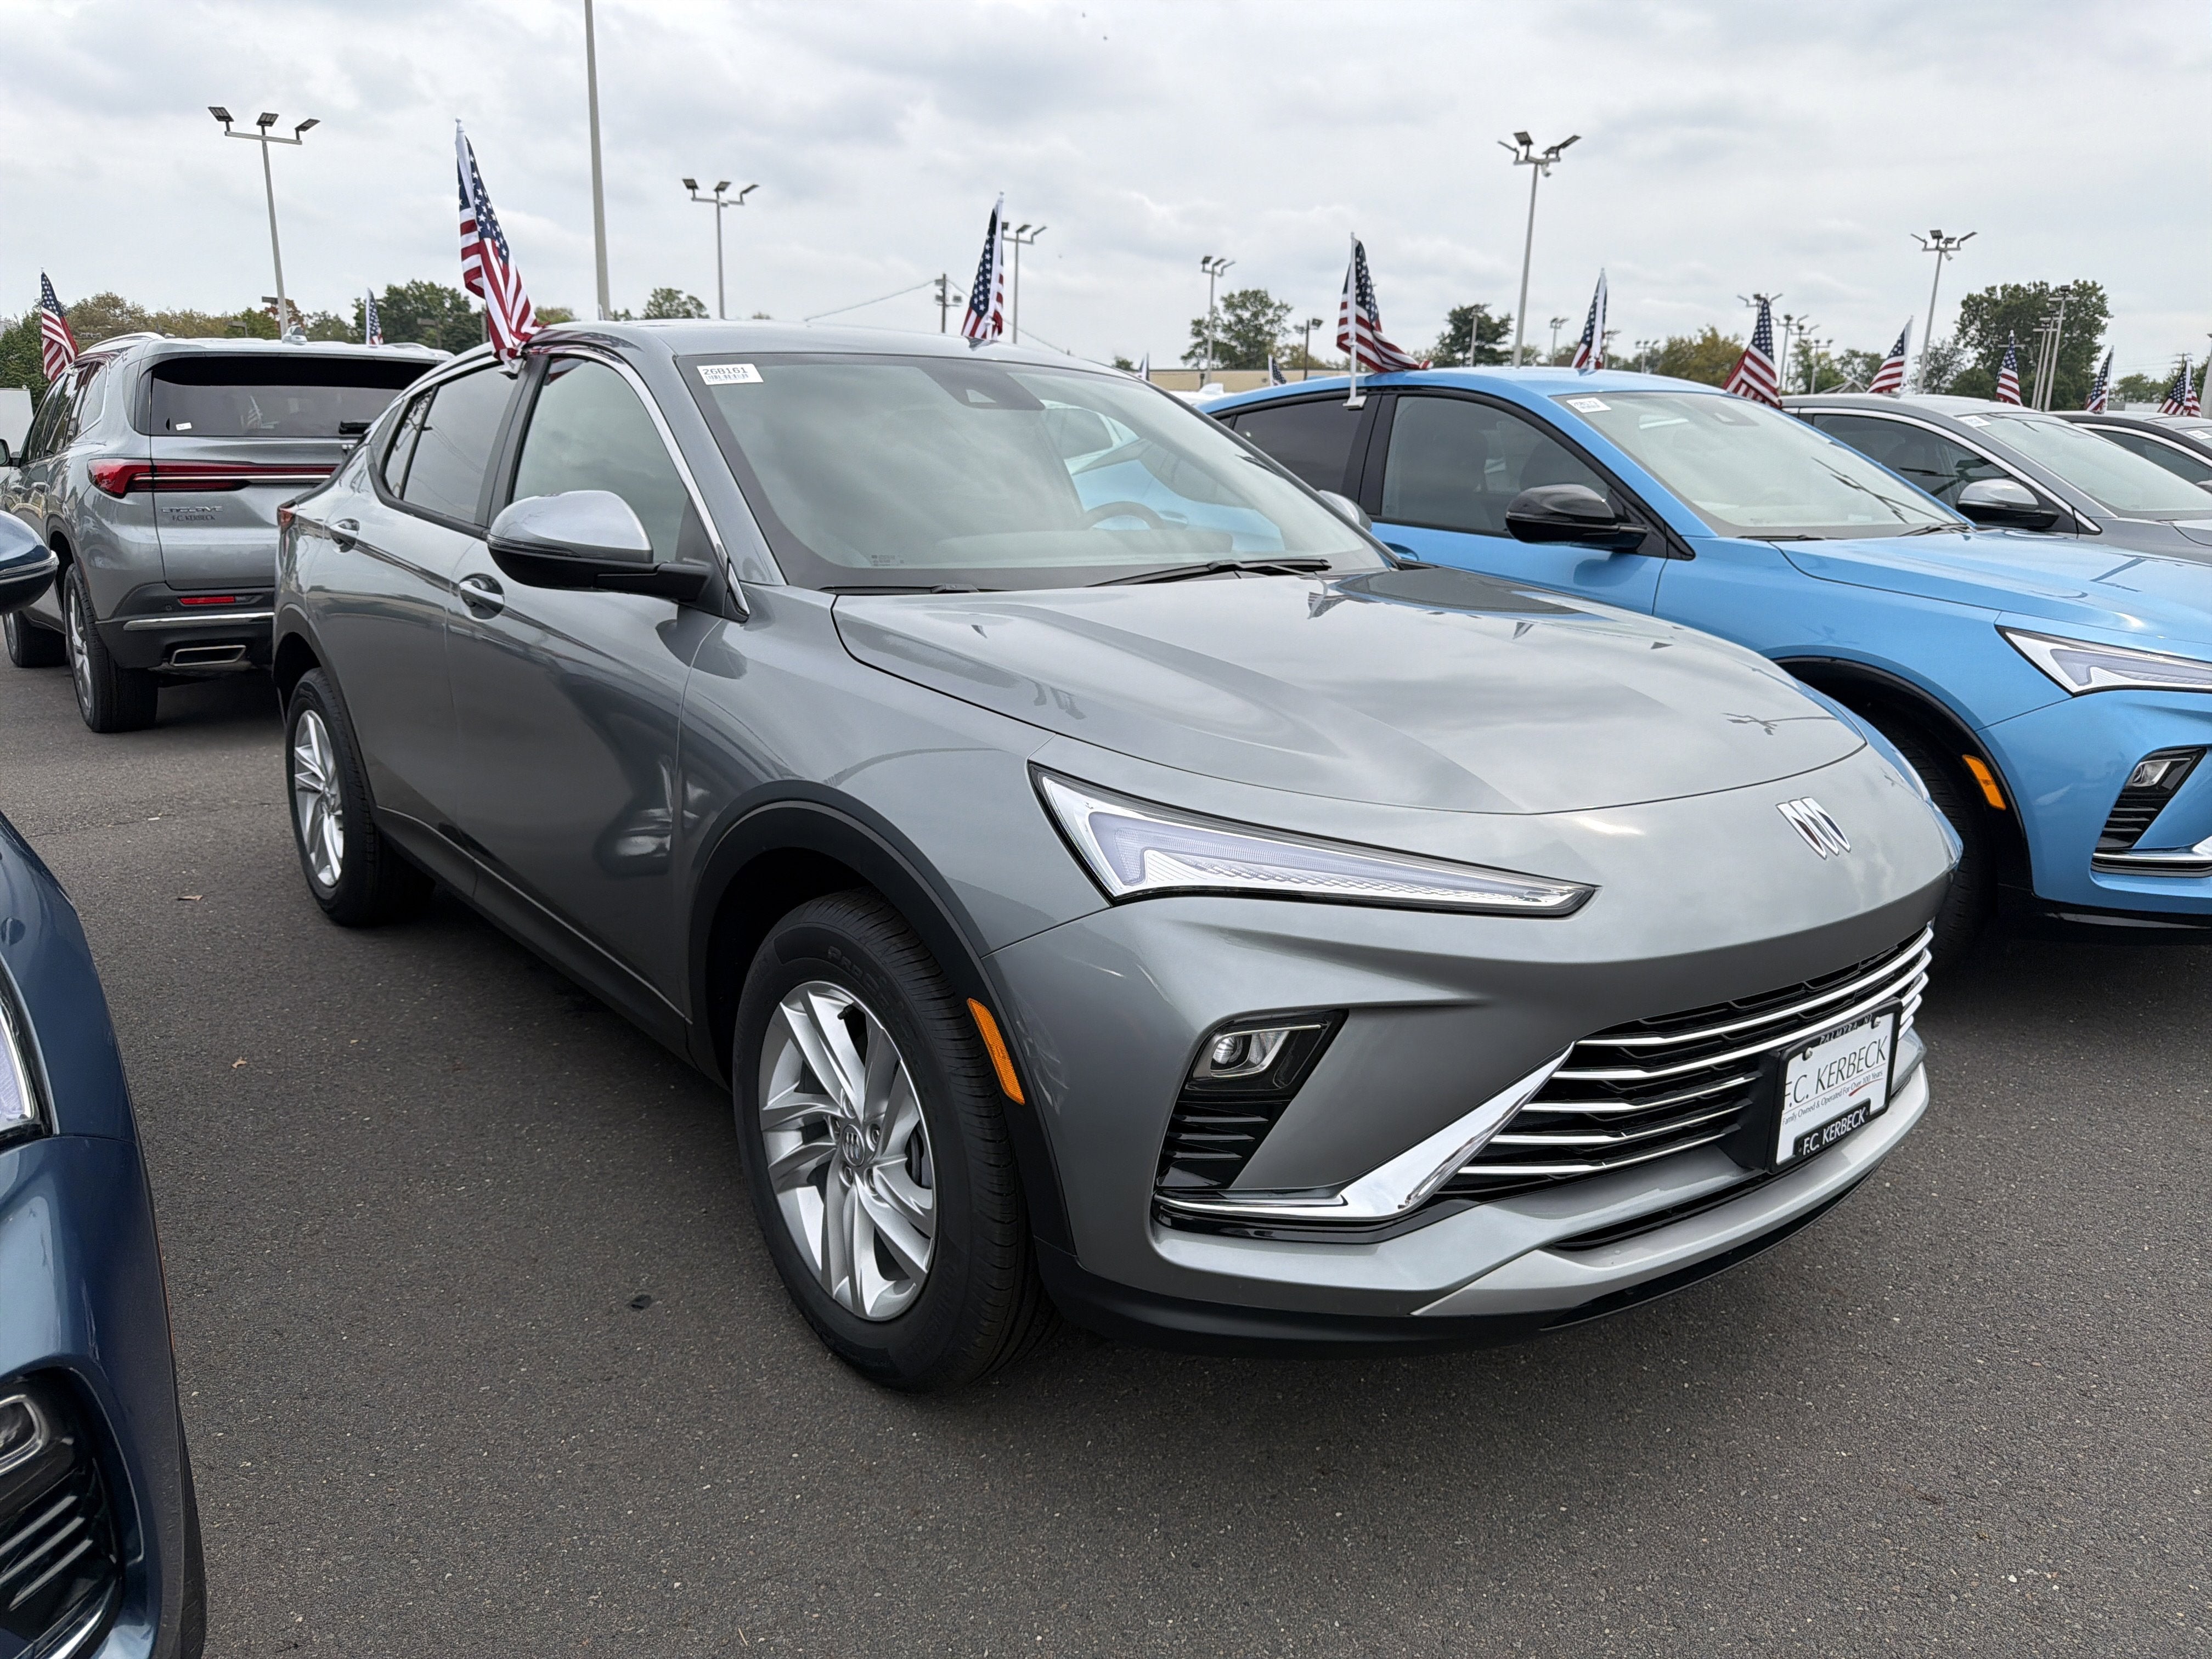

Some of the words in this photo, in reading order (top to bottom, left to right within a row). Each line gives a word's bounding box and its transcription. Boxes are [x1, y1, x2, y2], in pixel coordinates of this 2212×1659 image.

[703, 366, 748, 375] 26B161
[1815, 1035, 1888, 1094] KERBECK
[1782, 1112, 1797, 1126] Family
[1798, 1102, 1815, 1118] Owned
[1816, 1100, 1820, 1109] &
[1820, 1088, 1843, 1105] Operated
[1850, 1081, 1862, 1091] Over
[1863, 1074, 1871, 1084] 100
[1871, 1070, 1883, 1079] Years
[1803, 1132, 1820, 1156] F.C.
[1822, 1107, 1866, 1146] KERBECK
